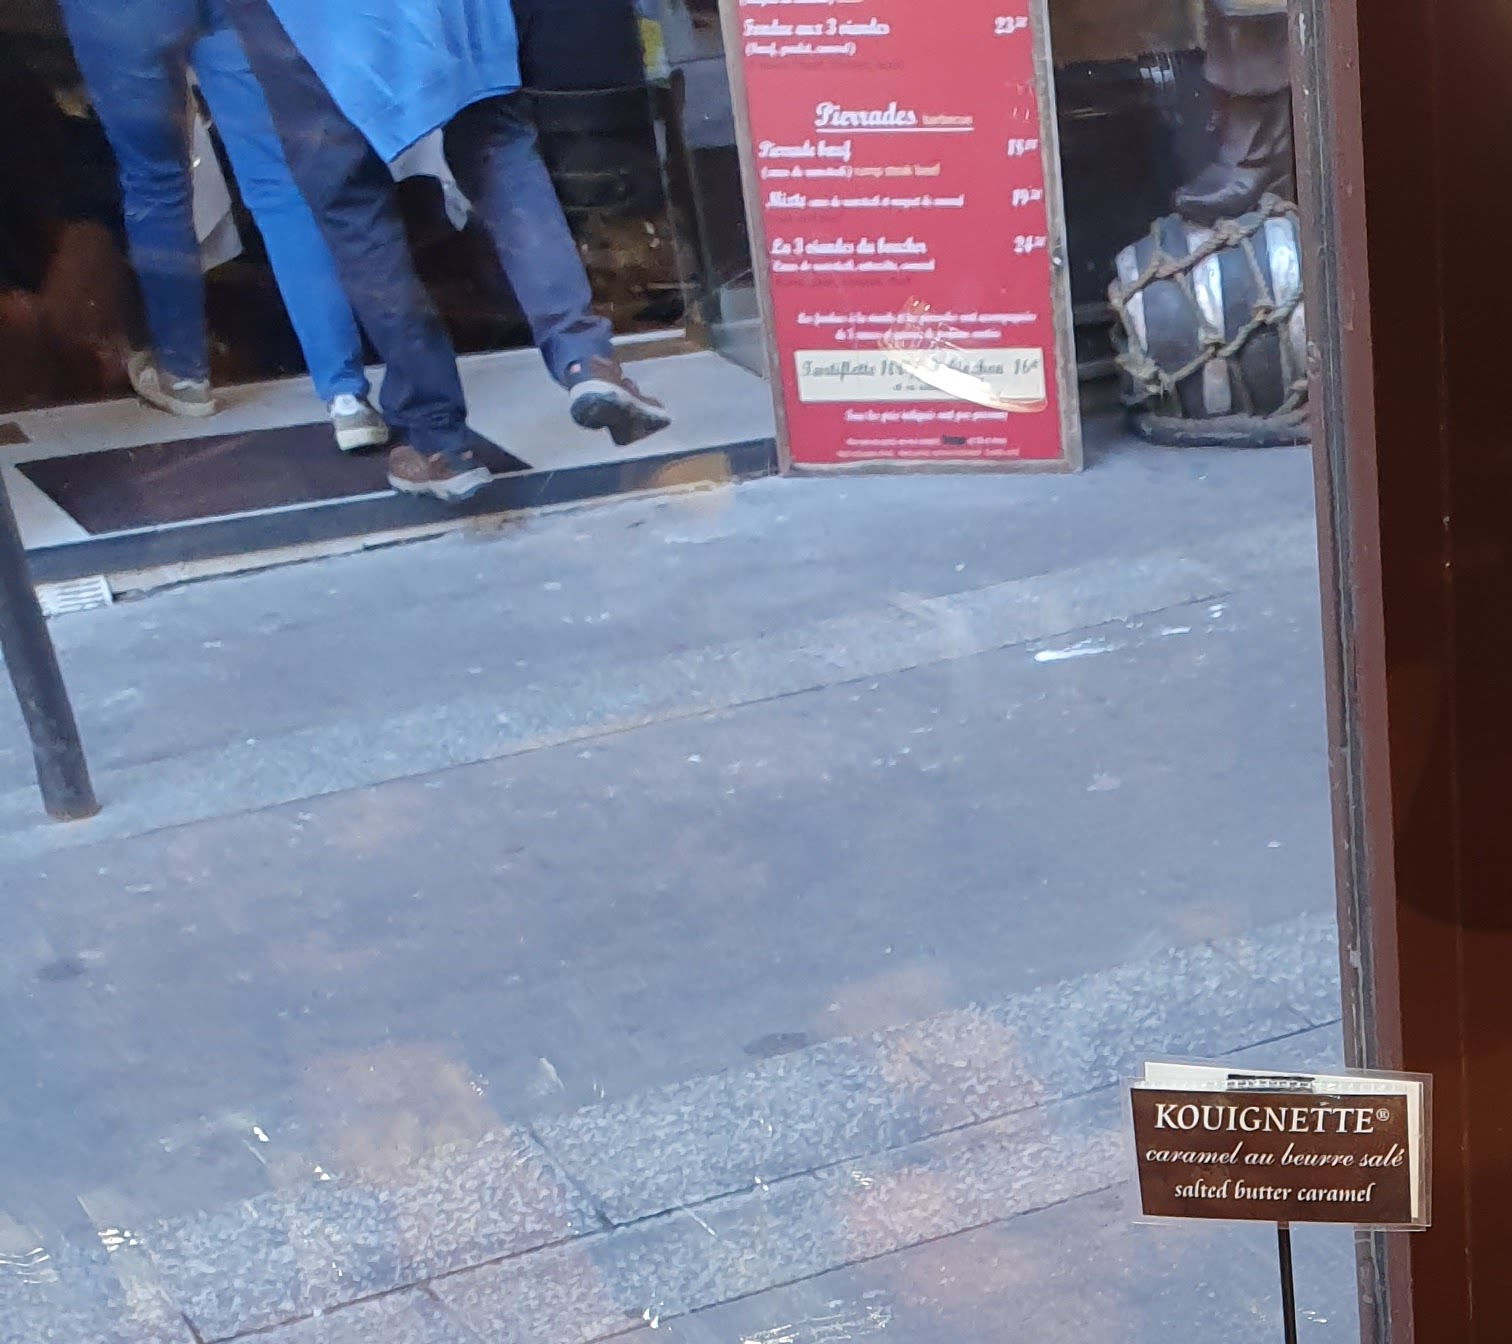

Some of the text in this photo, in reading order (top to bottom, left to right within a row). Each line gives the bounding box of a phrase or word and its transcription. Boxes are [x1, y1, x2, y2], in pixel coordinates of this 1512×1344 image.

[1145, 1141, 1406, 1168] caramel au beurre salé
[1174, 1179, 1377, 1203] salted butter caramel
